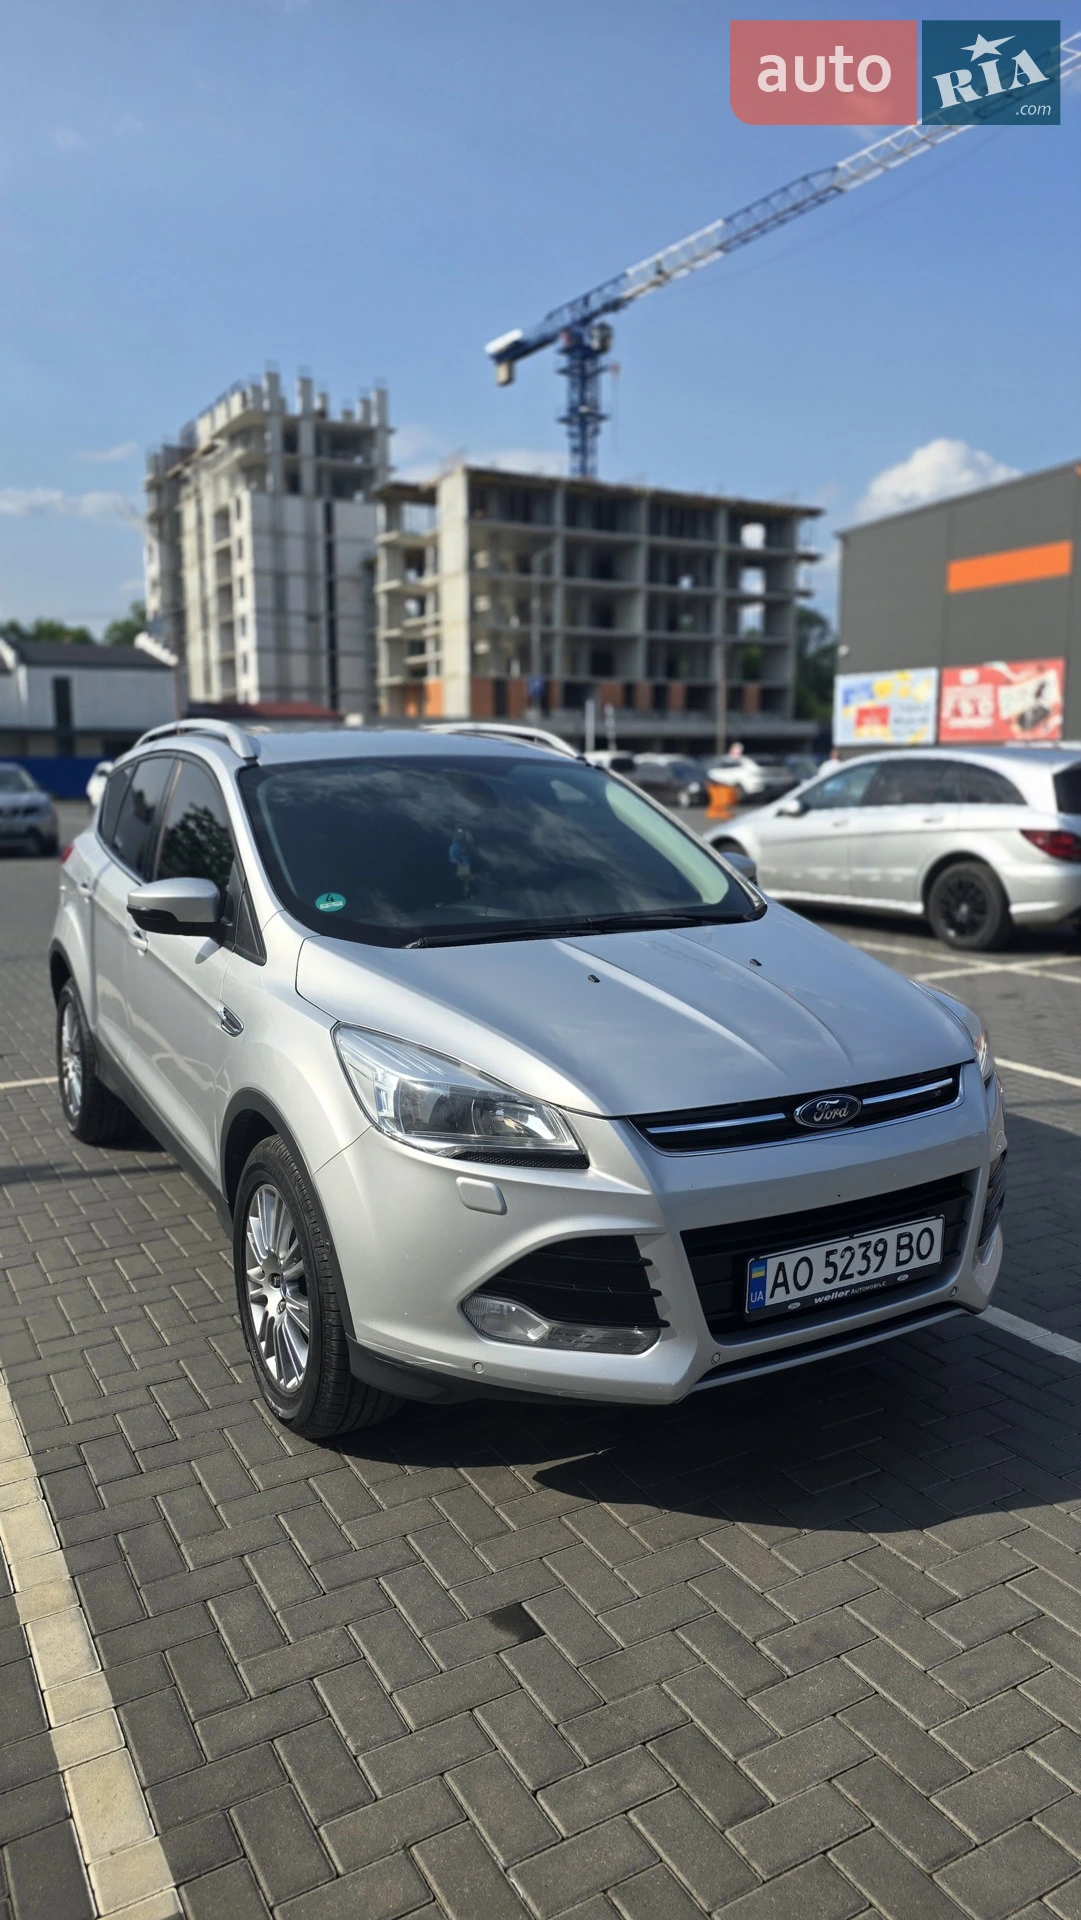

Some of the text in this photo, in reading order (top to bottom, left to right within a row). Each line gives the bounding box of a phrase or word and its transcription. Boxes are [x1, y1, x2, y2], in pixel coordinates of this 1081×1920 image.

[325, 893, 335, 902] 4
[813, 1099, 850, 1122] Ford
[769, 1227, 935, 1299] AO 5239 BO
[750, 1290, 764, 1303] UA
[814, 1289, 851, 1304] weller
